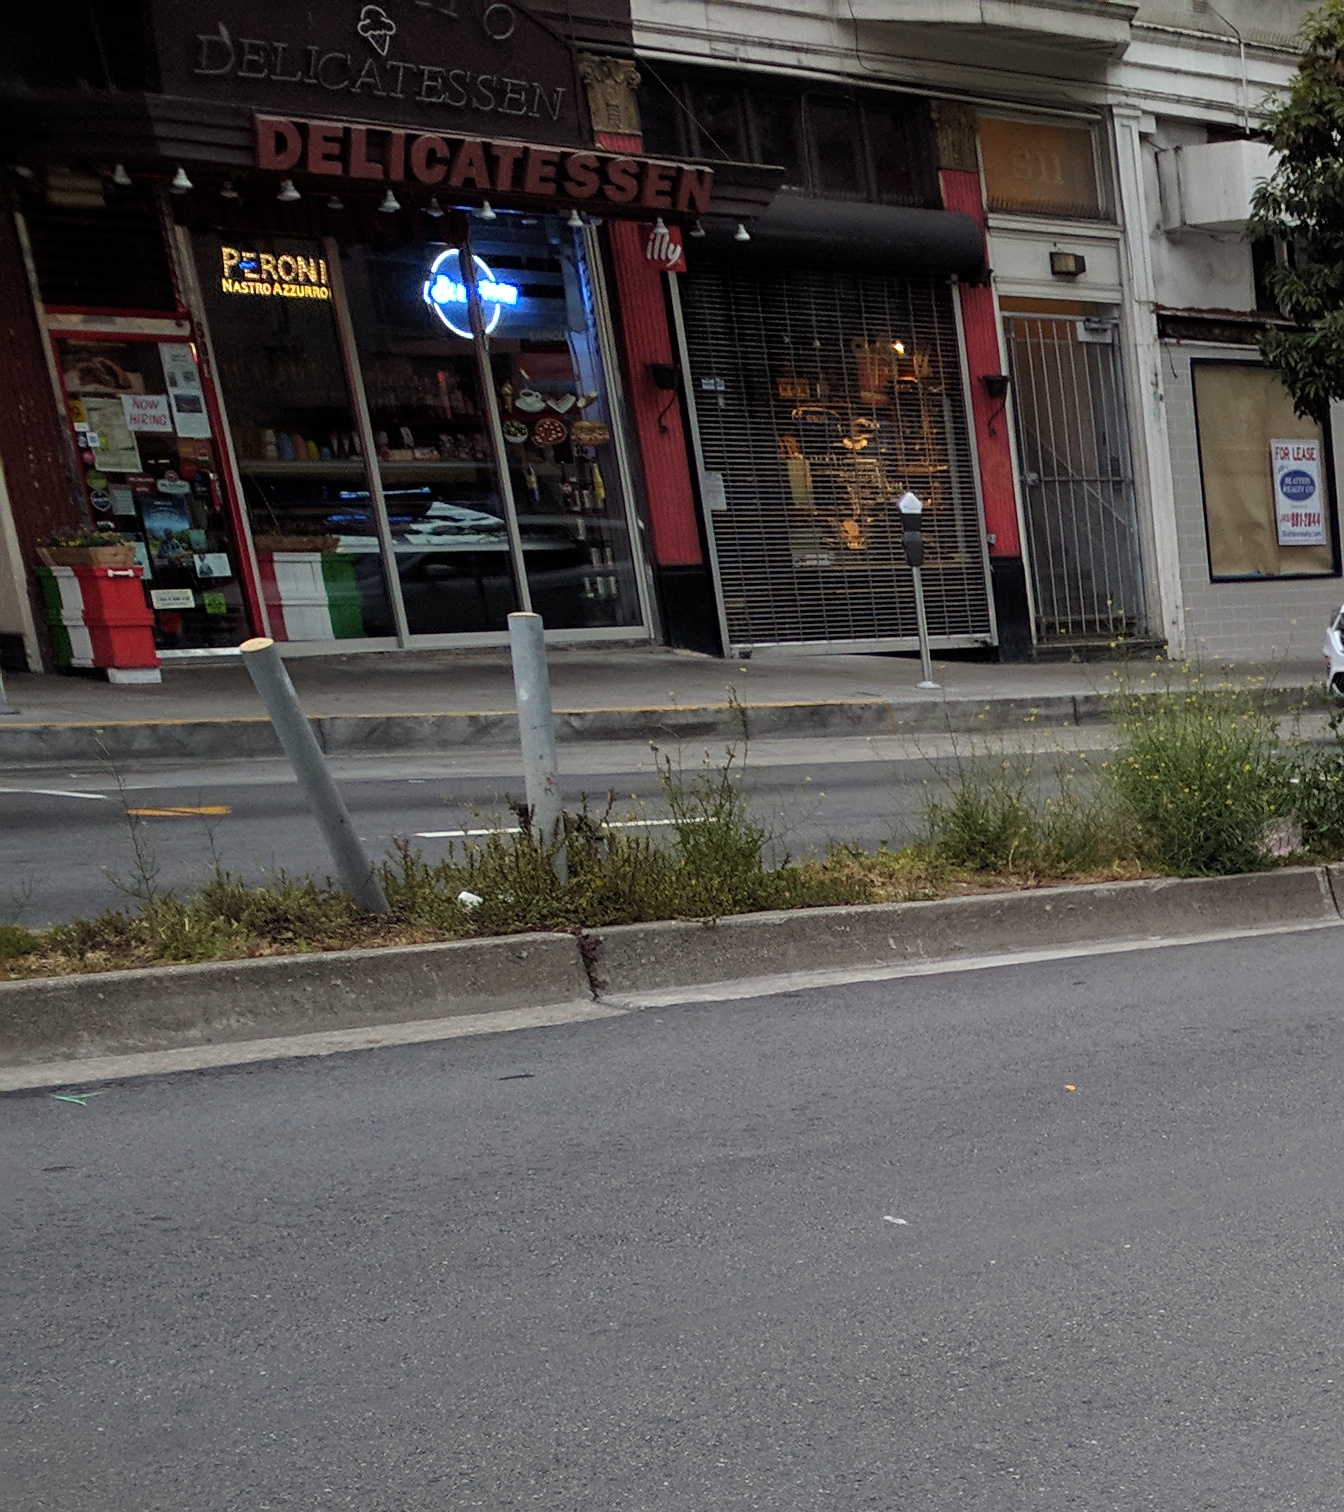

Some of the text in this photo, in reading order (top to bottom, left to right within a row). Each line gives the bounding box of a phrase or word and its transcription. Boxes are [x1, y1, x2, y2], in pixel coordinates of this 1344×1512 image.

[194, 32, 566, 121] DELICATESSEN
[254, 114, 715, 212] DELICATESSEN
[646, 232, 682, 267] illy
[221, 245, 328, 284] PERONI
[221, 278, 329, 300] NASTRO AZZURRO
[131, 398, 160, 410] NOW
[129, 413, 167, 426] HIRING
[1275, 446, 1316, 461] FOR LEASE
